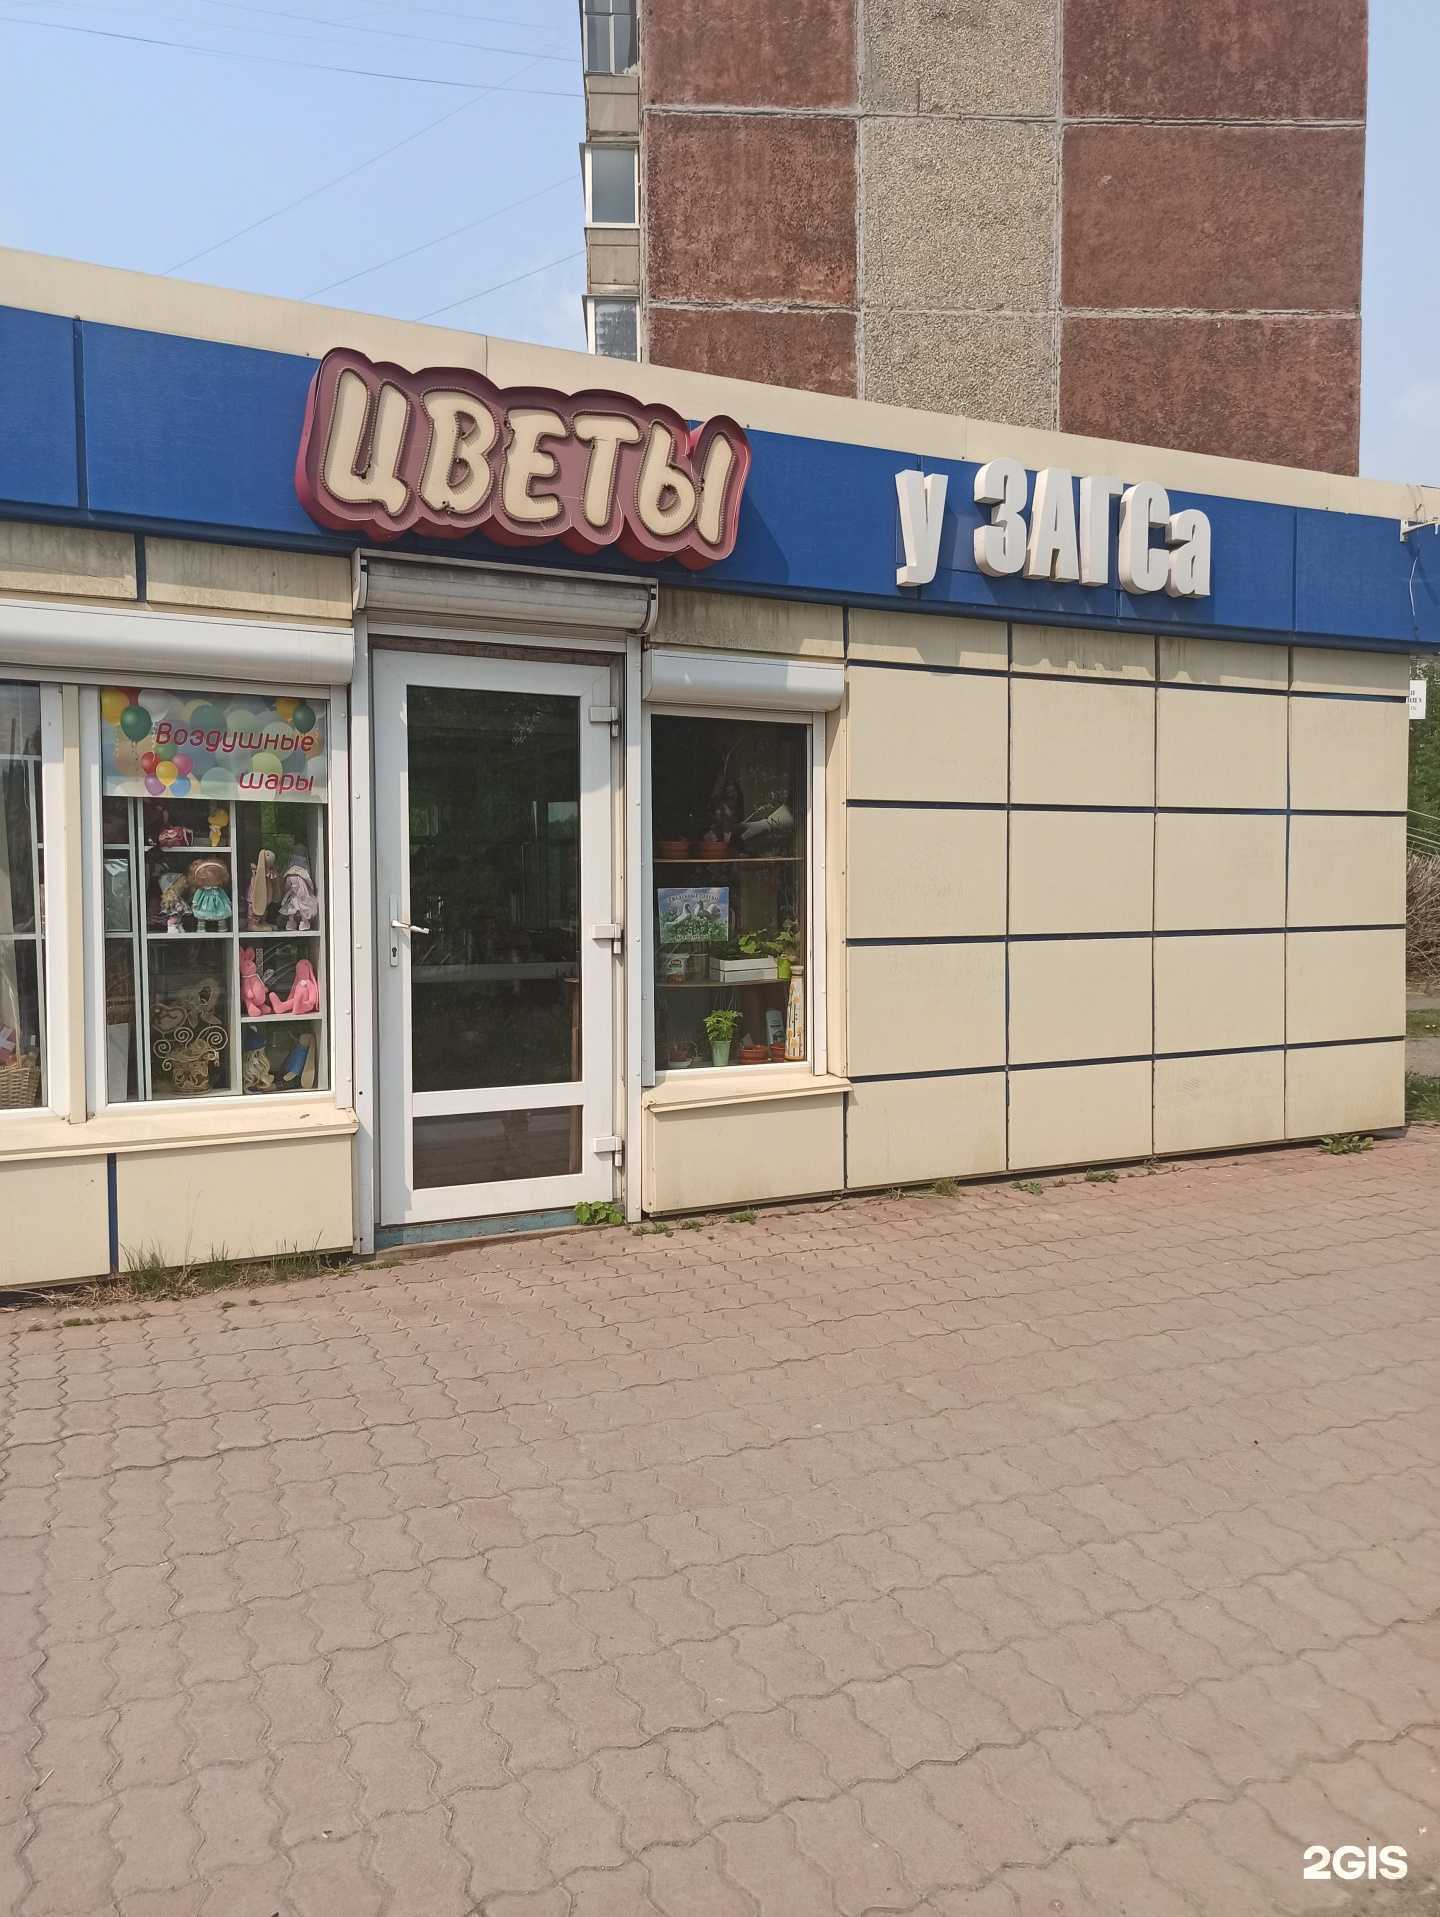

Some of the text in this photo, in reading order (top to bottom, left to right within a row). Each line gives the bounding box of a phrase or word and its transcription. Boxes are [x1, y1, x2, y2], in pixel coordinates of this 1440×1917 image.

[320, 367, 737, 546] ЦВЕТЫ
[973, 457, 1212, 598] ЗАГСа
[155, 722, 314, 752] Воздушные
[239, 772, 314, 793] шары
